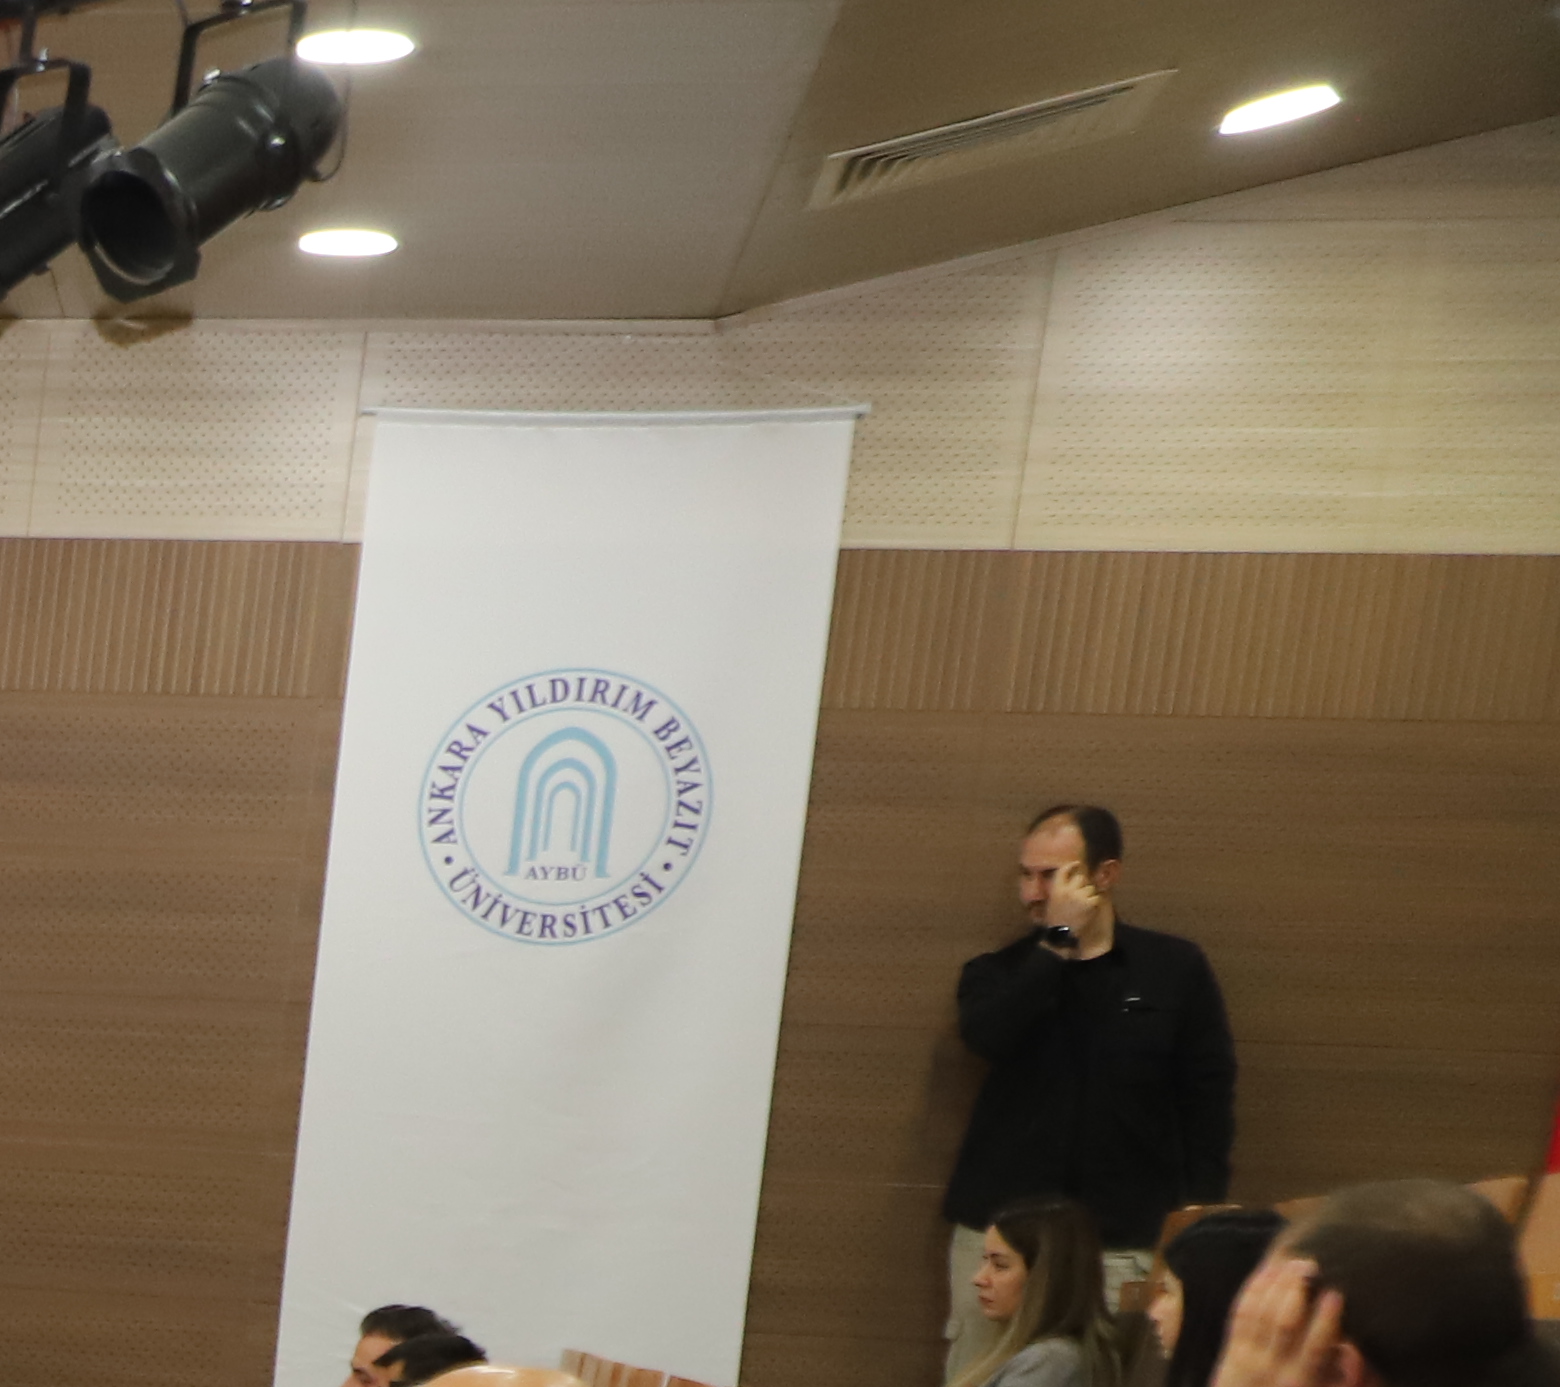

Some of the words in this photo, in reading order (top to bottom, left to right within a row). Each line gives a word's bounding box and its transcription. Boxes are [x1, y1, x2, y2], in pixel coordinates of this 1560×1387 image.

[427, 723, 491, 846] ANKARA
[487, 676, 659, 724] YILDIRIM
[653, 716, 704, 856] BEYAZIT
[448, 867, 667, 939] ÜNİVERSİTESİ
[524, 865, 588, 882] AYBÜ
